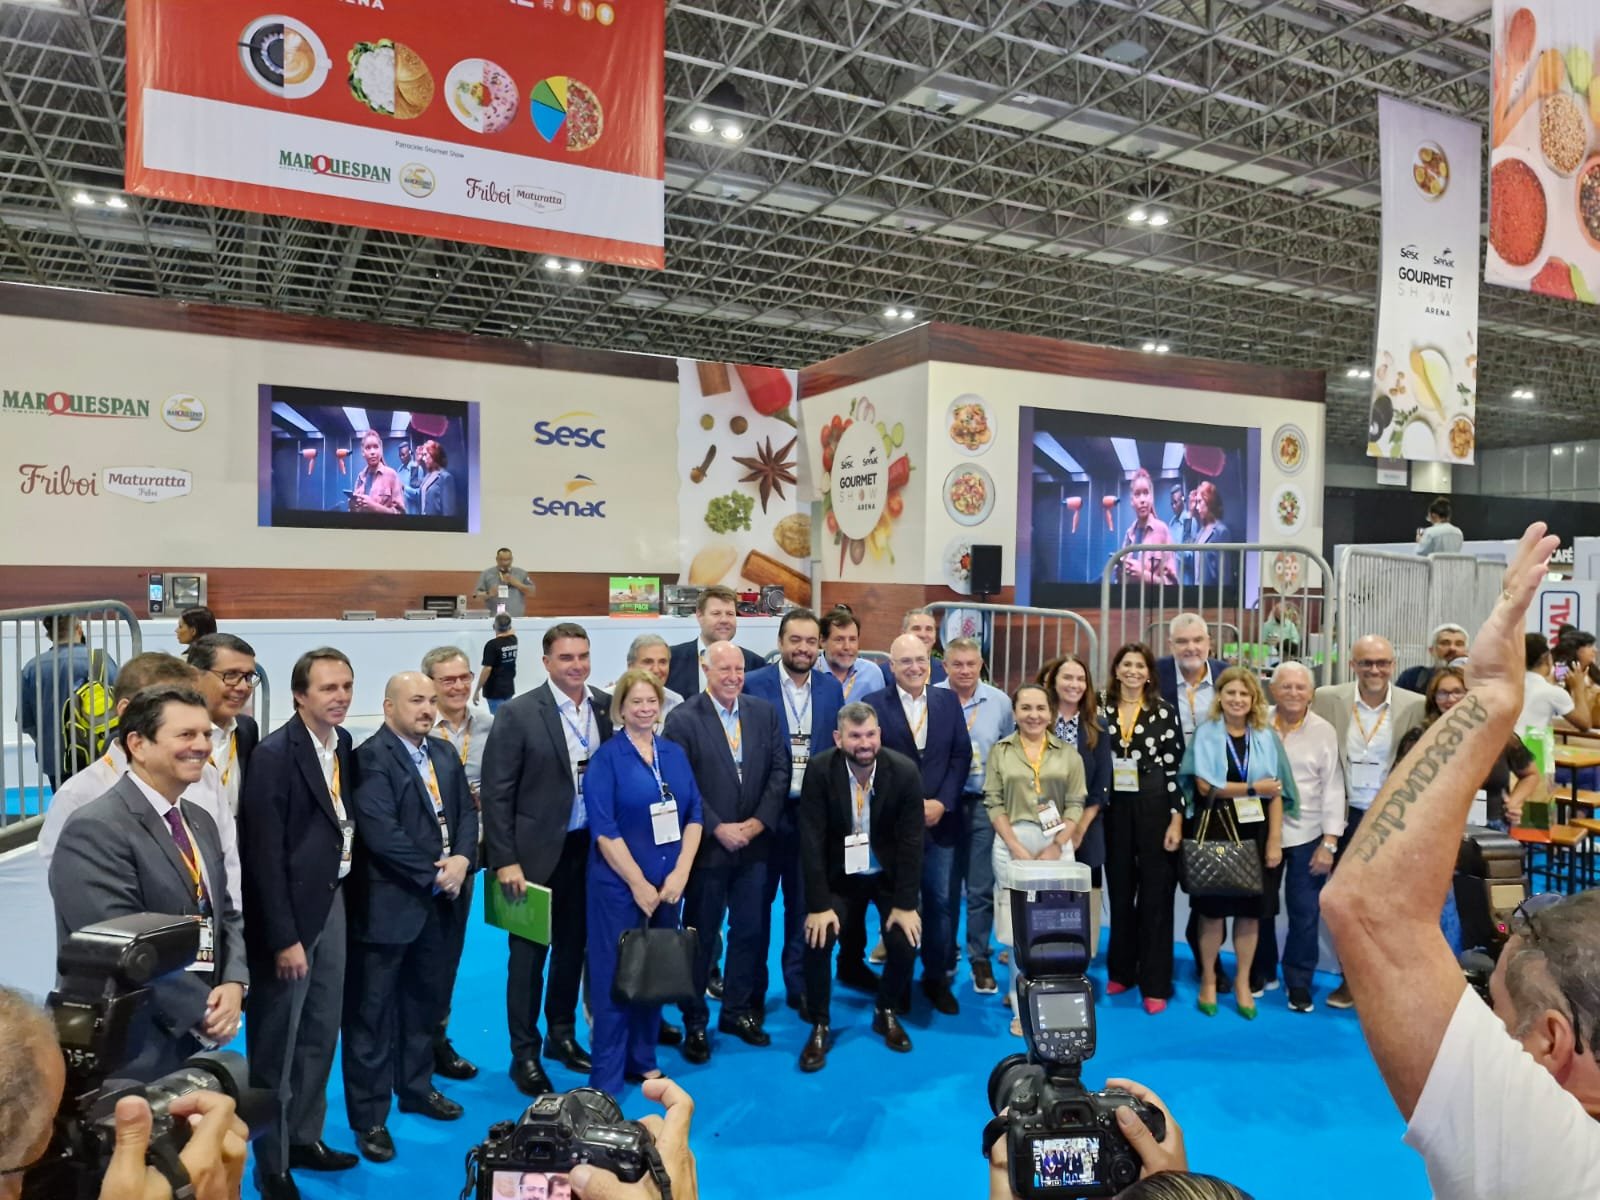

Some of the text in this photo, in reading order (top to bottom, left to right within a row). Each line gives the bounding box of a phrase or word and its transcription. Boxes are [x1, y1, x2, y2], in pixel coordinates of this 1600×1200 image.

[279, 150, 391, 183] MARQUESPAN
[466, 177, 562, 205] Friboi Maturatta
[1398, 266, 1453, 289] GOURMET
[1425, 306, 1450, 317] ARENA
[2, 390, 150, 417] MARQUESPAN
[534, 421, 606, 449] Sesc
[18, 463, 186, 497] Friboi Maturatta
[840, 472, 877, 489] GOURMET
[532, 496, 606, 518] Senac
[857, 503, 876, 511] ARENA
[1354, 694, 1488, 863] Alexandra
